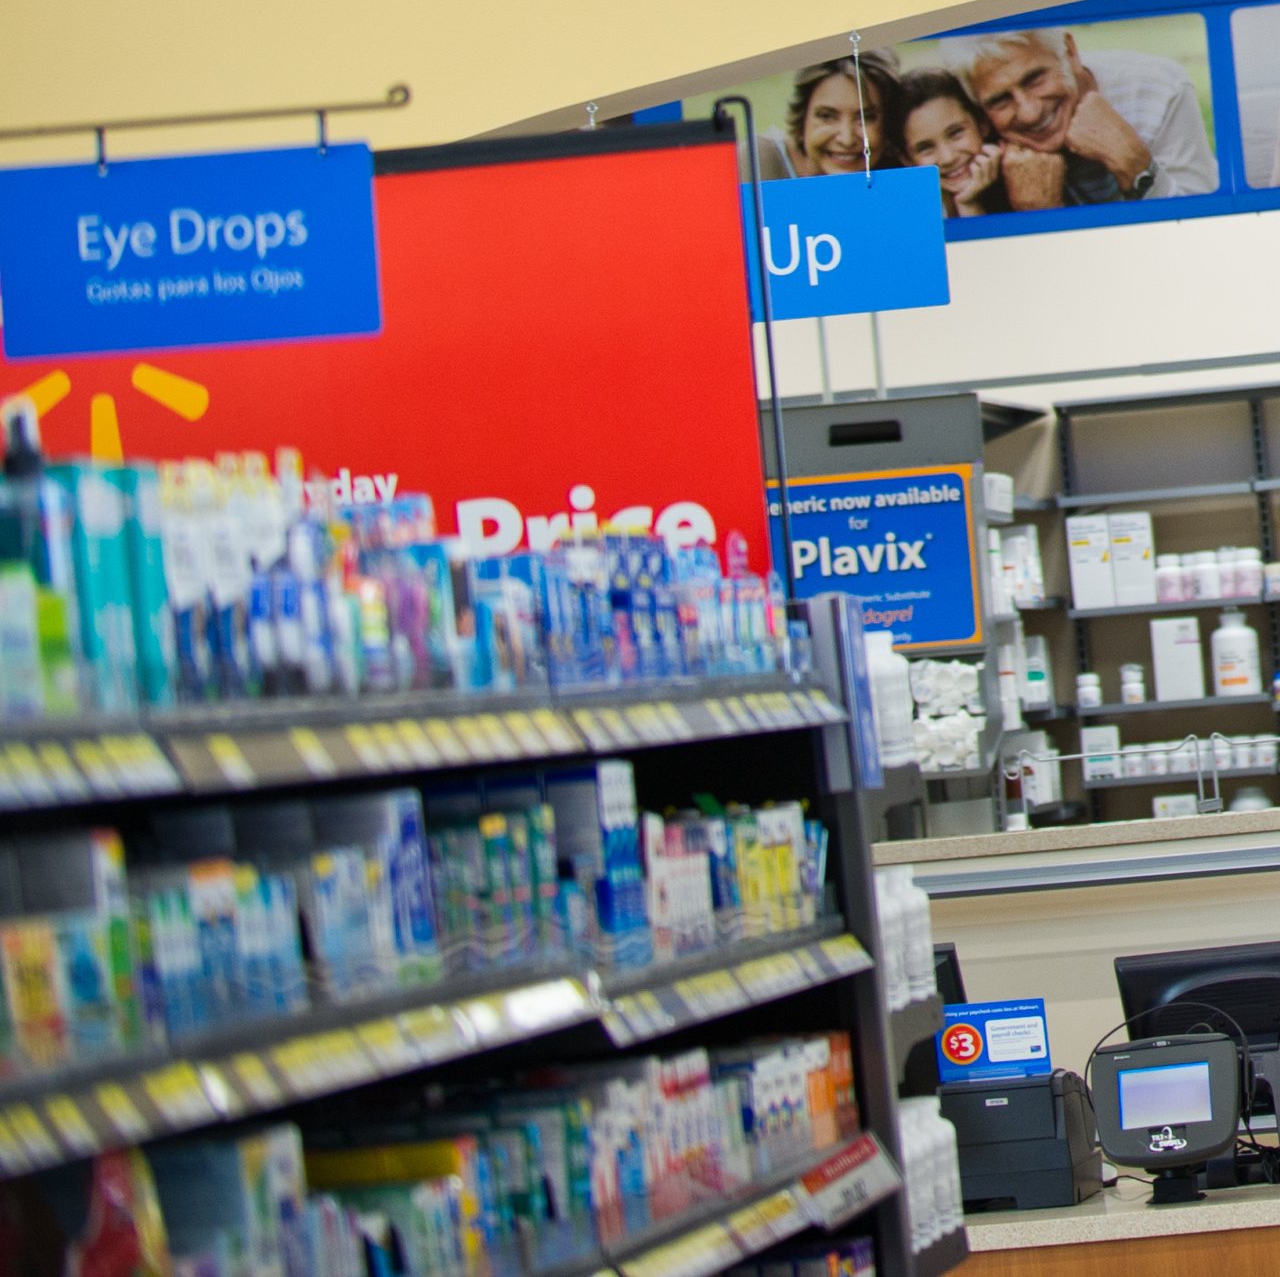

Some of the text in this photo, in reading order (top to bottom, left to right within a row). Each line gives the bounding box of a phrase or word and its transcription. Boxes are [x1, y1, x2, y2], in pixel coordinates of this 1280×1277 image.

[78, 208, 309, 271] Eye Drops
[763, 224, 842, 286] Up
[830, 494, 871, 511] now
[874, 484, 961, 507] available
[848, 516, 868, 530] for
[791, 531, 927, 580] Plavix
[949, 1032, 975, 1057] $3
